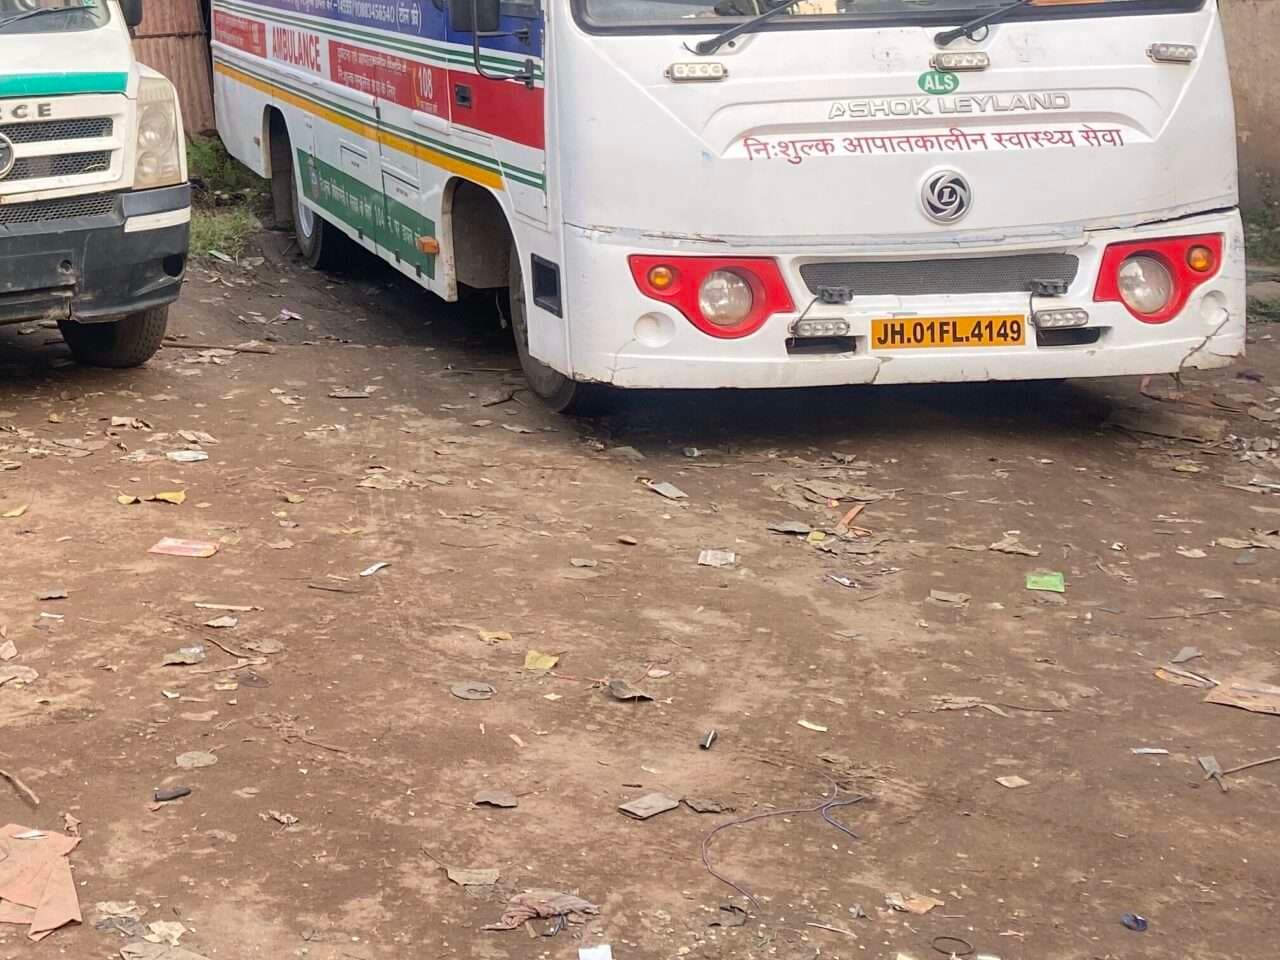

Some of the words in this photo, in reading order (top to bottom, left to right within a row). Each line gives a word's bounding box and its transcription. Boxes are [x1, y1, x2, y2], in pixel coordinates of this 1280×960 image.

[272, 25, 321, 73] AMBULANCE
[418, 67, 433, 100] 108
[924, 75, 955, 92] ALS
[827, 96, 932, 119] ASHOK
[939, 93, 1071, 114] LEYLAND
[843, 127, 988, 155] आपातकालीन
[992, 127, 1076, 151] स्वास्थ्य
[1080, 124, 1125, 147] सेवा
[877, 319, 1022, 345] JH.01FL.4149
